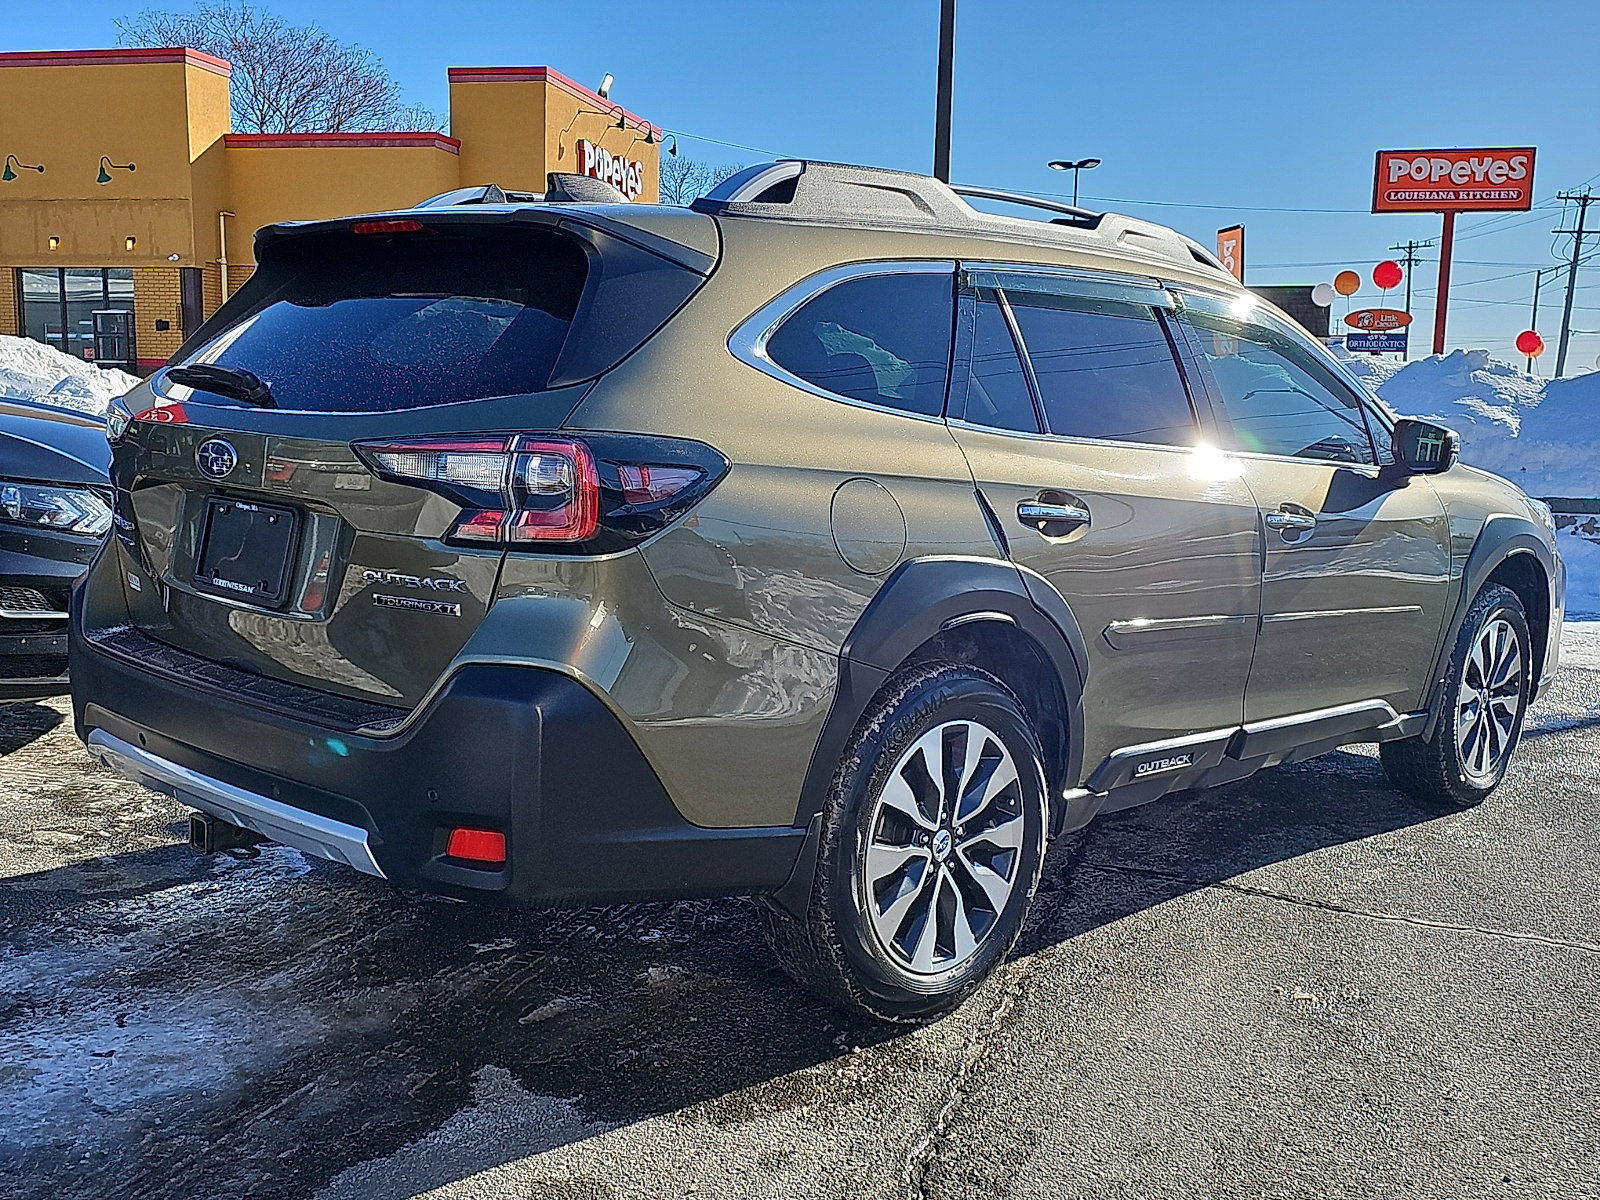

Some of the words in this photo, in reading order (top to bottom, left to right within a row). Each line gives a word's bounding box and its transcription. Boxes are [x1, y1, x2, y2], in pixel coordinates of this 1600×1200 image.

[1388, 156, 1528, 184] POPeYeS
[1390, 190, 1455, 200] LOUISIANA
[1458, 190, 1519, 200] KITCHEN
[1348, 340, 1406, 348] ORTHODONTICS
[362, 569, 468, 594] OUTBACK
[380, 597, 432, 611] TOURING
[432, 603, 455, 614] XT
[1138, 754, 1191, 773] OUTBACK
